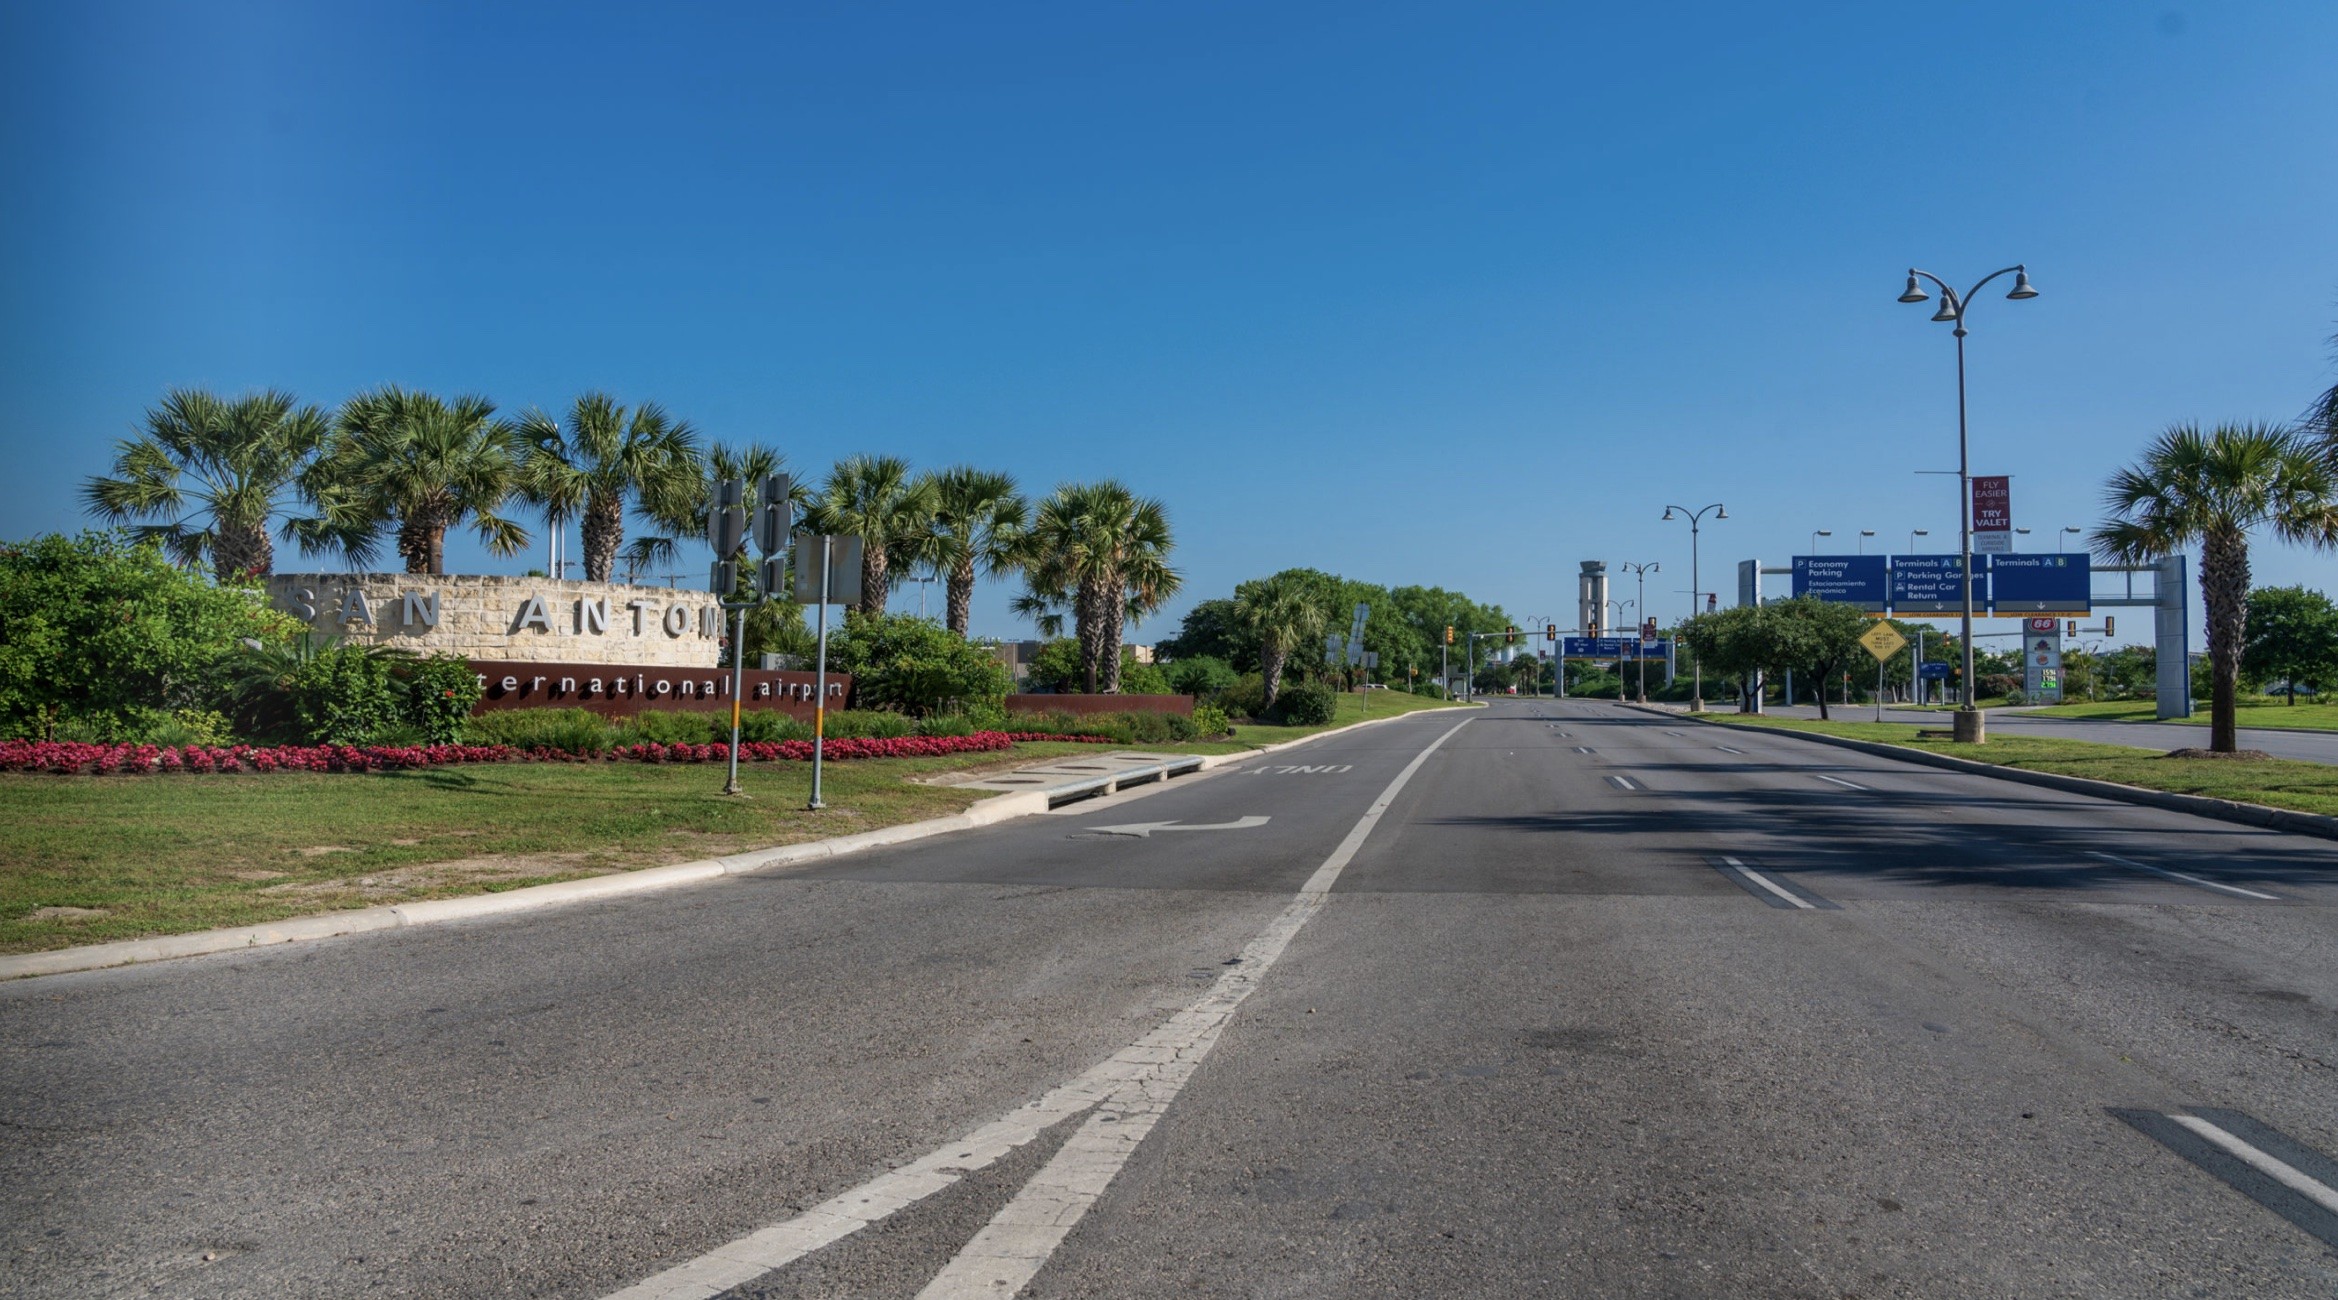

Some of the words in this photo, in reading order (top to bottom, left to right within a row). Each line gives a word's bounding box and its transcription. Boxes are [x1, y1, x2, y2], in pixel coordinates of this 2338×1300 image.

[1975, 489, 2007, 498] EASIER
[1976, 518, 2007, 526] VALET
[1808, 569, 1842, 578] Parking
[1907, 572, 1942, 580] Parking
[286, 588, 440, 626] SAN
[2034, 620, 2052, 628] 66
[761, 675, 842, 701] airprt
